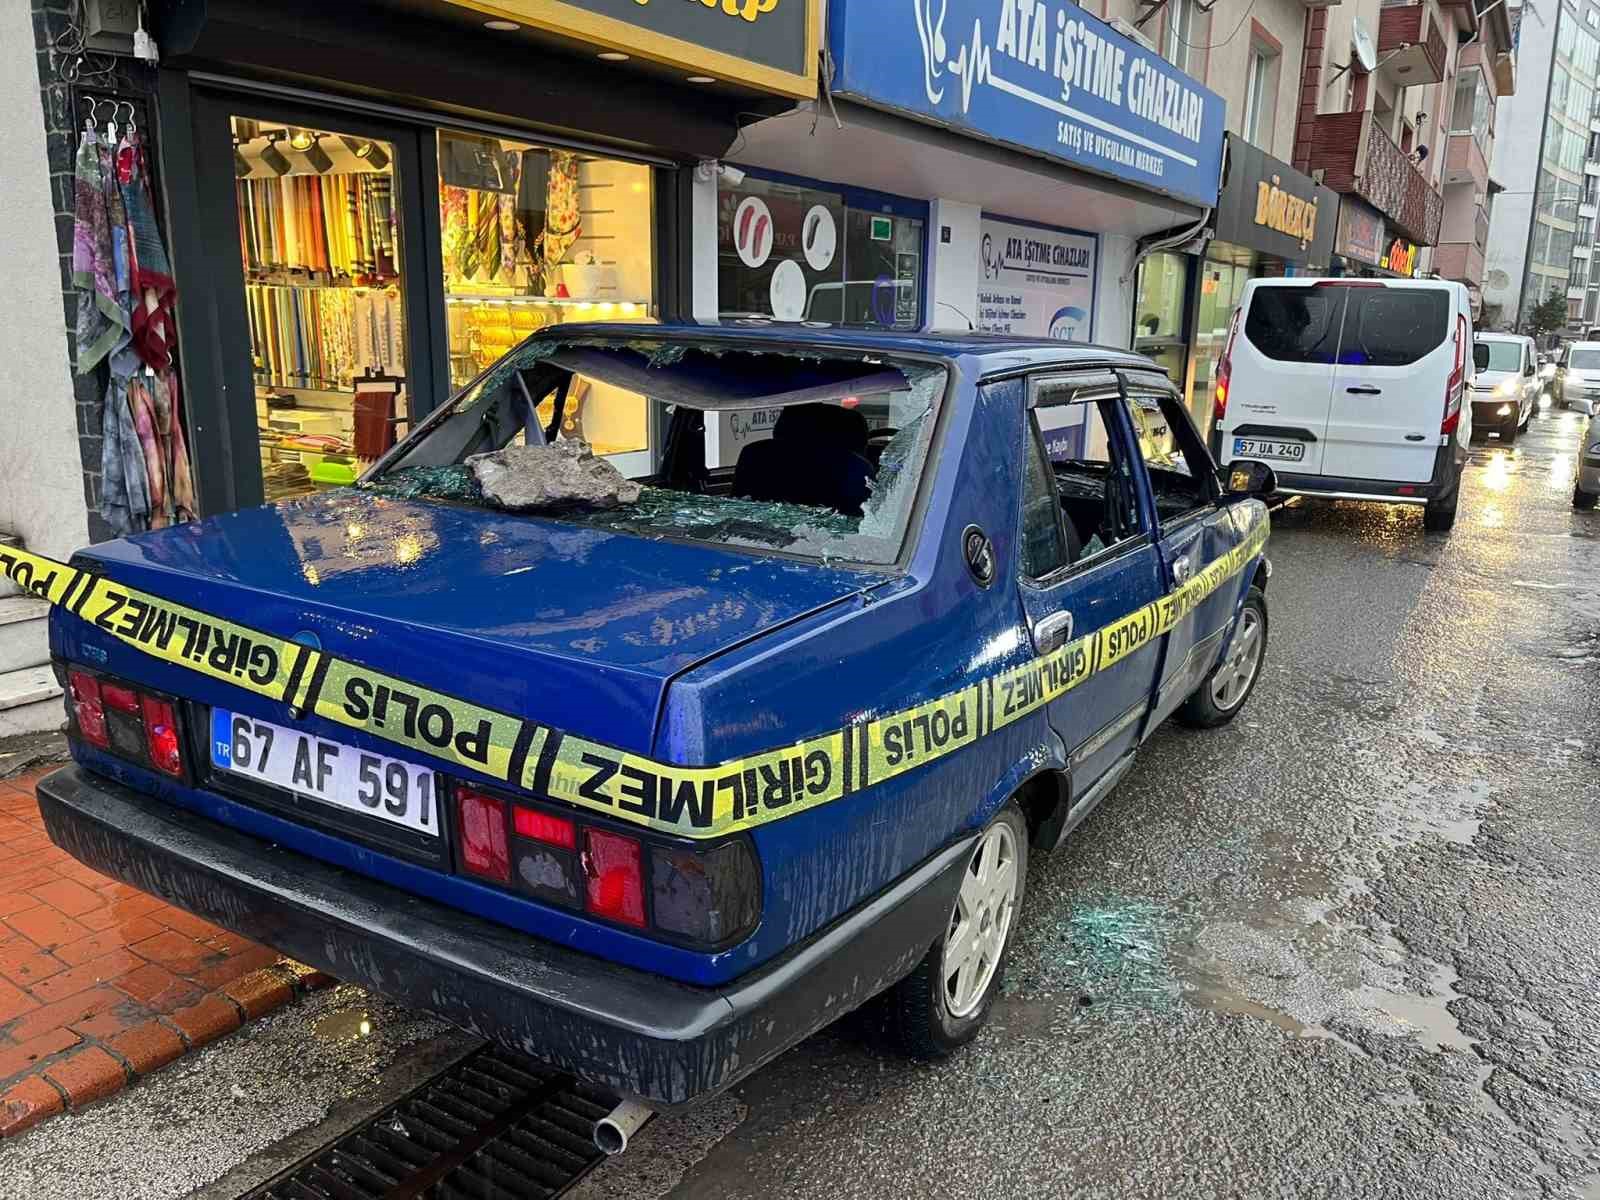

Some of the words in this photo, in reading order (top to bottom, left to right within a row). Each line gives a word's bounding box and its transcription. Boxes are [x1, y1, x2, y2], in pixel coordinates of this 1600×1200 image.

[996, 0, 1047, 71] ATA
[1083, 130, 1094, 153] VE
[1094, 135, 1135, 167] UYGULAMA
[1005, 238, 1022, 260] ATA
[752, 411, 768, 426] ATA
[1241, 441, 1255, 453] 67
[1259, 443, 1273, 454] UA
[1278, 445, 1301, 457] 240
[216, 740, 230, 758] TR
[232, 716, 274, 773] 67
[291, 735, 340, 792] AF
[357, 754, 431, 826] 591
